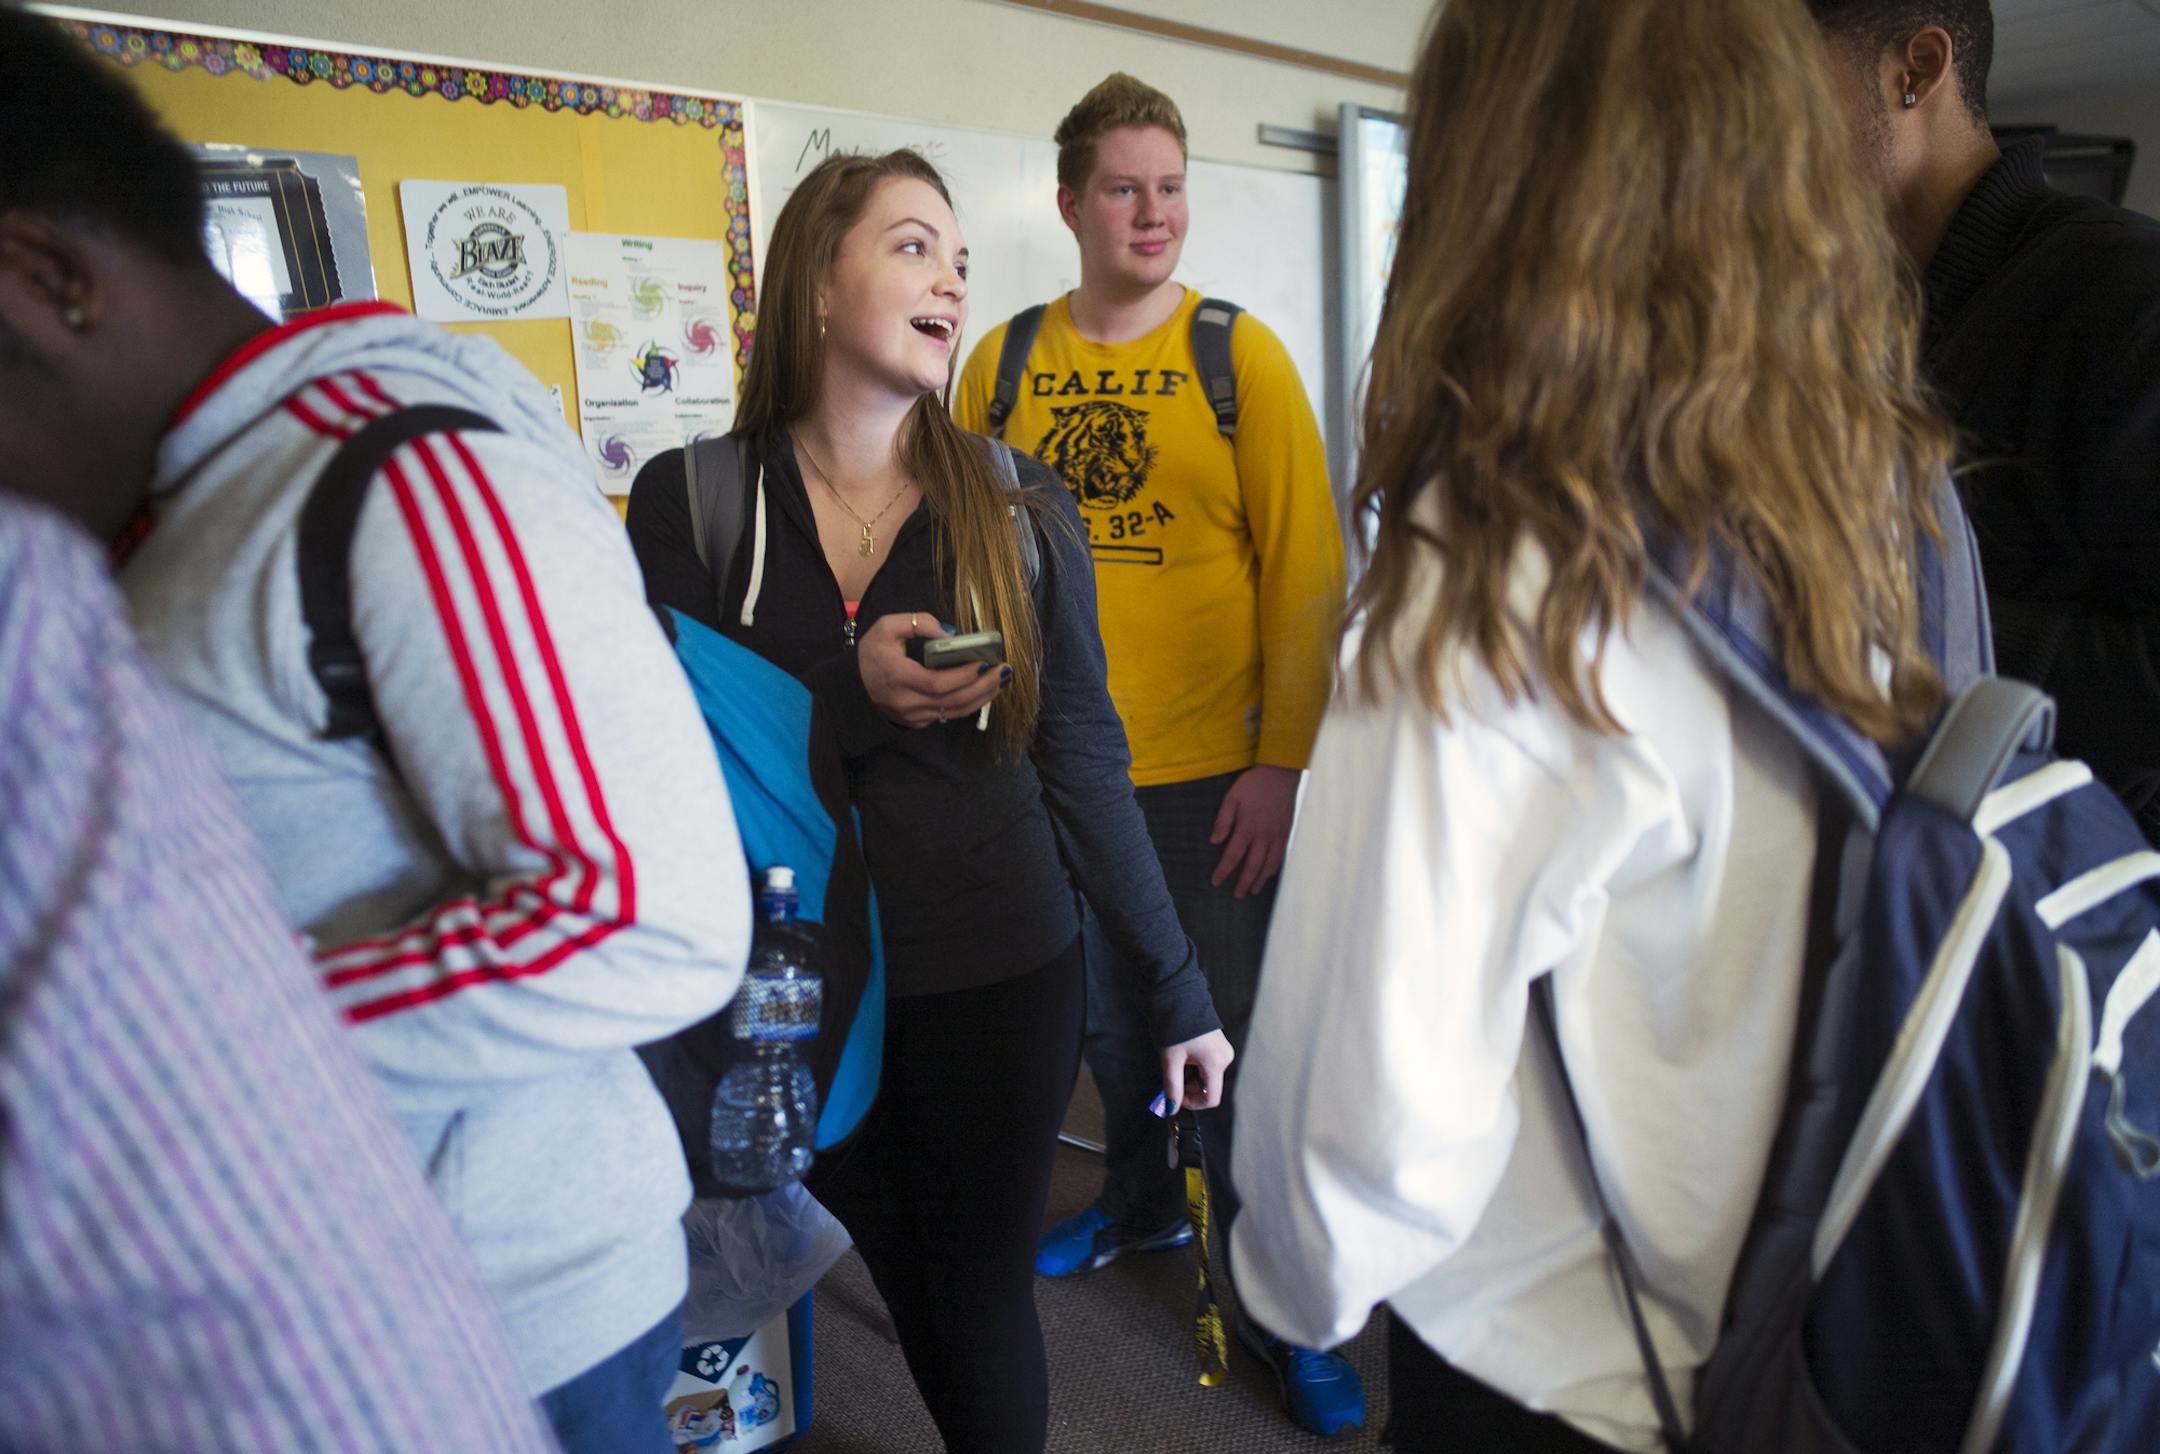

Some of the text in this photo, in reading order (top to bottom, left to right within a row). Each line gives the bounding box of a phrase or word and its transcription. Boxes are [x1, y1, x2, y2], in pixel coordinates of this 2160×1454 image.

[622, 239, 653, 251] Writing
[1033, 369, 1188, 397] CALIF
[1109, 500, 1175, 539] 32-A
